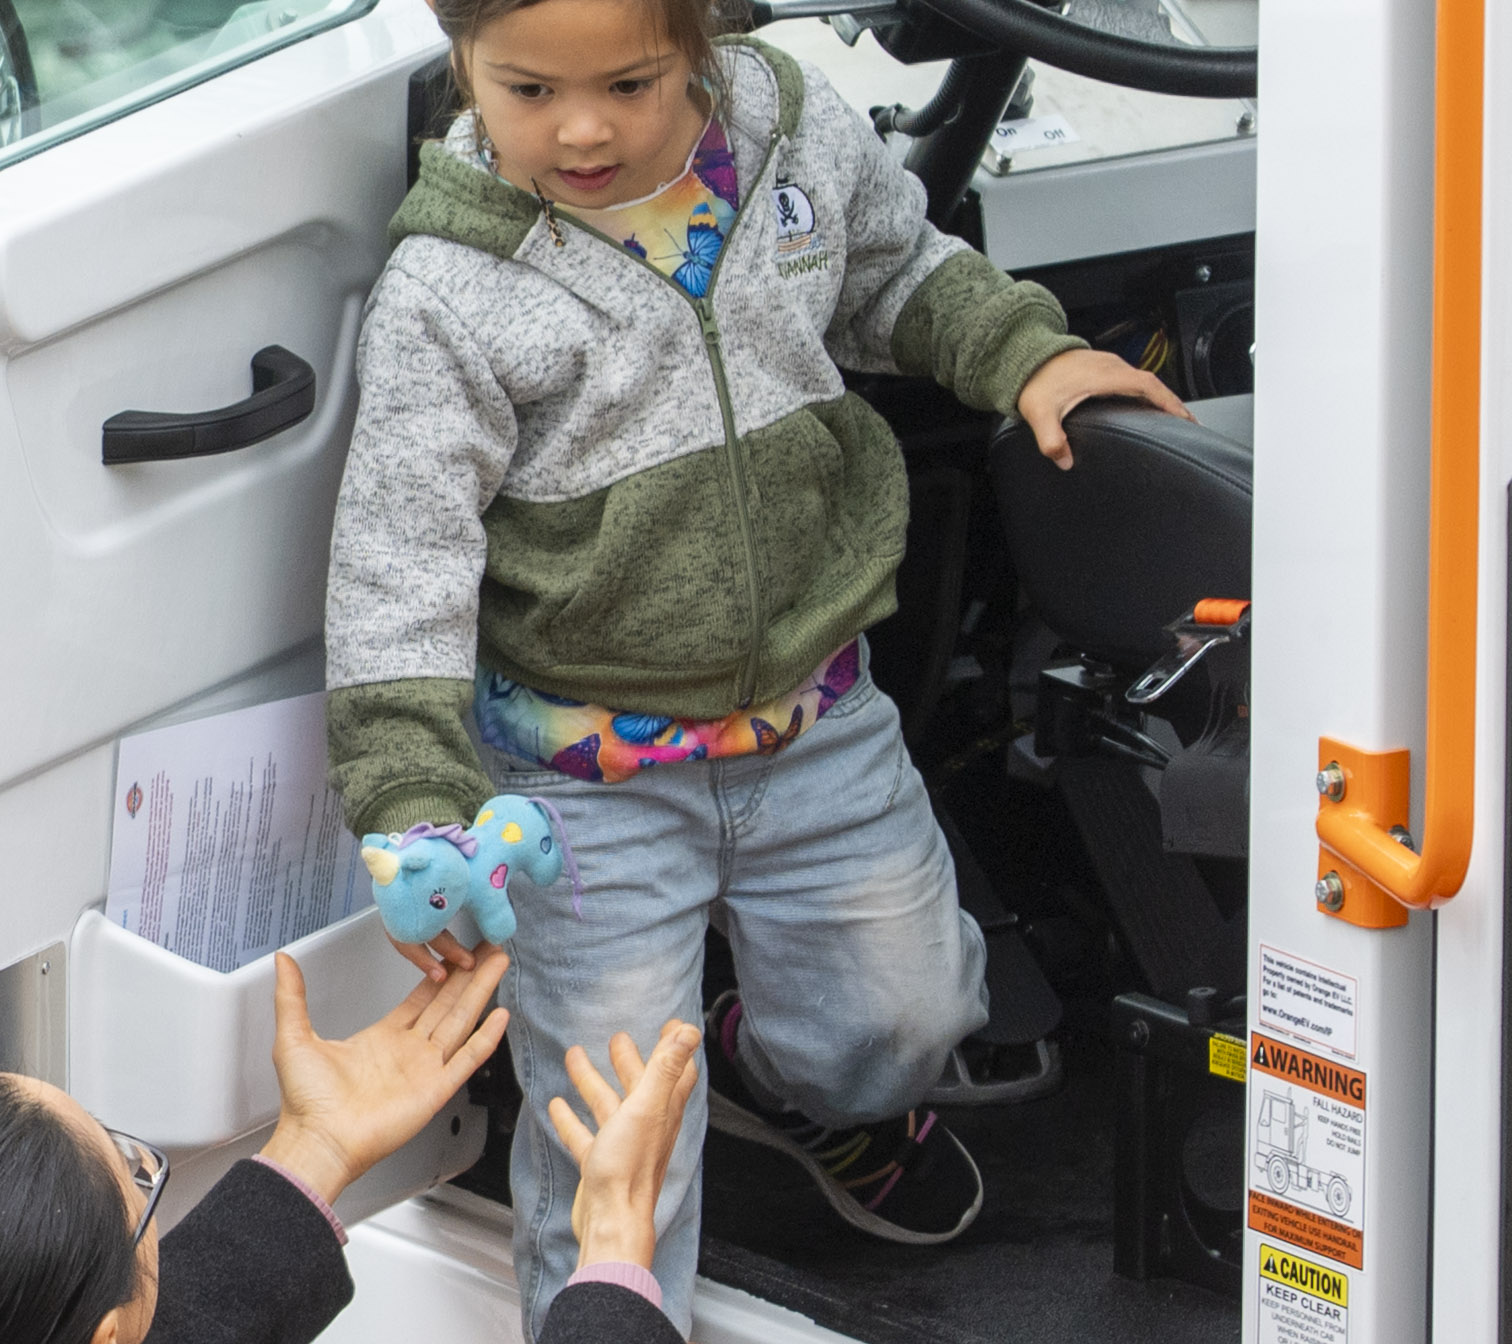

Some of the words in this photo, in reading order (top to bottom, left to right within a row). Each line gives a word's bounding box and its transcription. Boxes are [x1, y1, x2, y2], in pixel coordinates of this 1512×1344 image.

[996, 127, 1017, 138] On
[1043, 128, 1066, 140] Off
[1263, 964, 1285, 980] Property
[1312, 983, 1331, 998] Orange
[1270, 1045, 1363, 1101] WARNING
[1313, 1096, 1330, 1112] FALL
[1331, 1103, 1363, 1123] HAZARD
[1249, 1191, 1265, 1203] FACE
[1295, 1208, 1316, 1222] WHILE
[1317, 1215, 1351, 1235] ENTERING
[1252, 1204, 1280, 1222] EXITING
[1280, 1214, 1307, 1233] VEHICLE
[1308, 1226, 1321, 1238] USE
[1264, 1221, 1279, 1232] FOR
[1279, 1227, 1314, 1247] MAXIMUM
[1315, 1241, 1346, 1258] SUPPORT
[1280, 1257, 1341, 1299] CAUTION
[1261, 1298, 1280, 1309] KEEP
[1281, 1304, 1322, 1327] PERSONNEL
[1324, 1321, 1345, 1334] FROM
[1266, 1283, 1298, 1303] KEEP
[1300, 1297, 1341, 1321] CLEAR
[1271, 1312, 1318, 1336] UNDERNEATH
[1277, 1325, 1298, 1338] WHEN
[1277, 1336, 1288, 1344] OR
